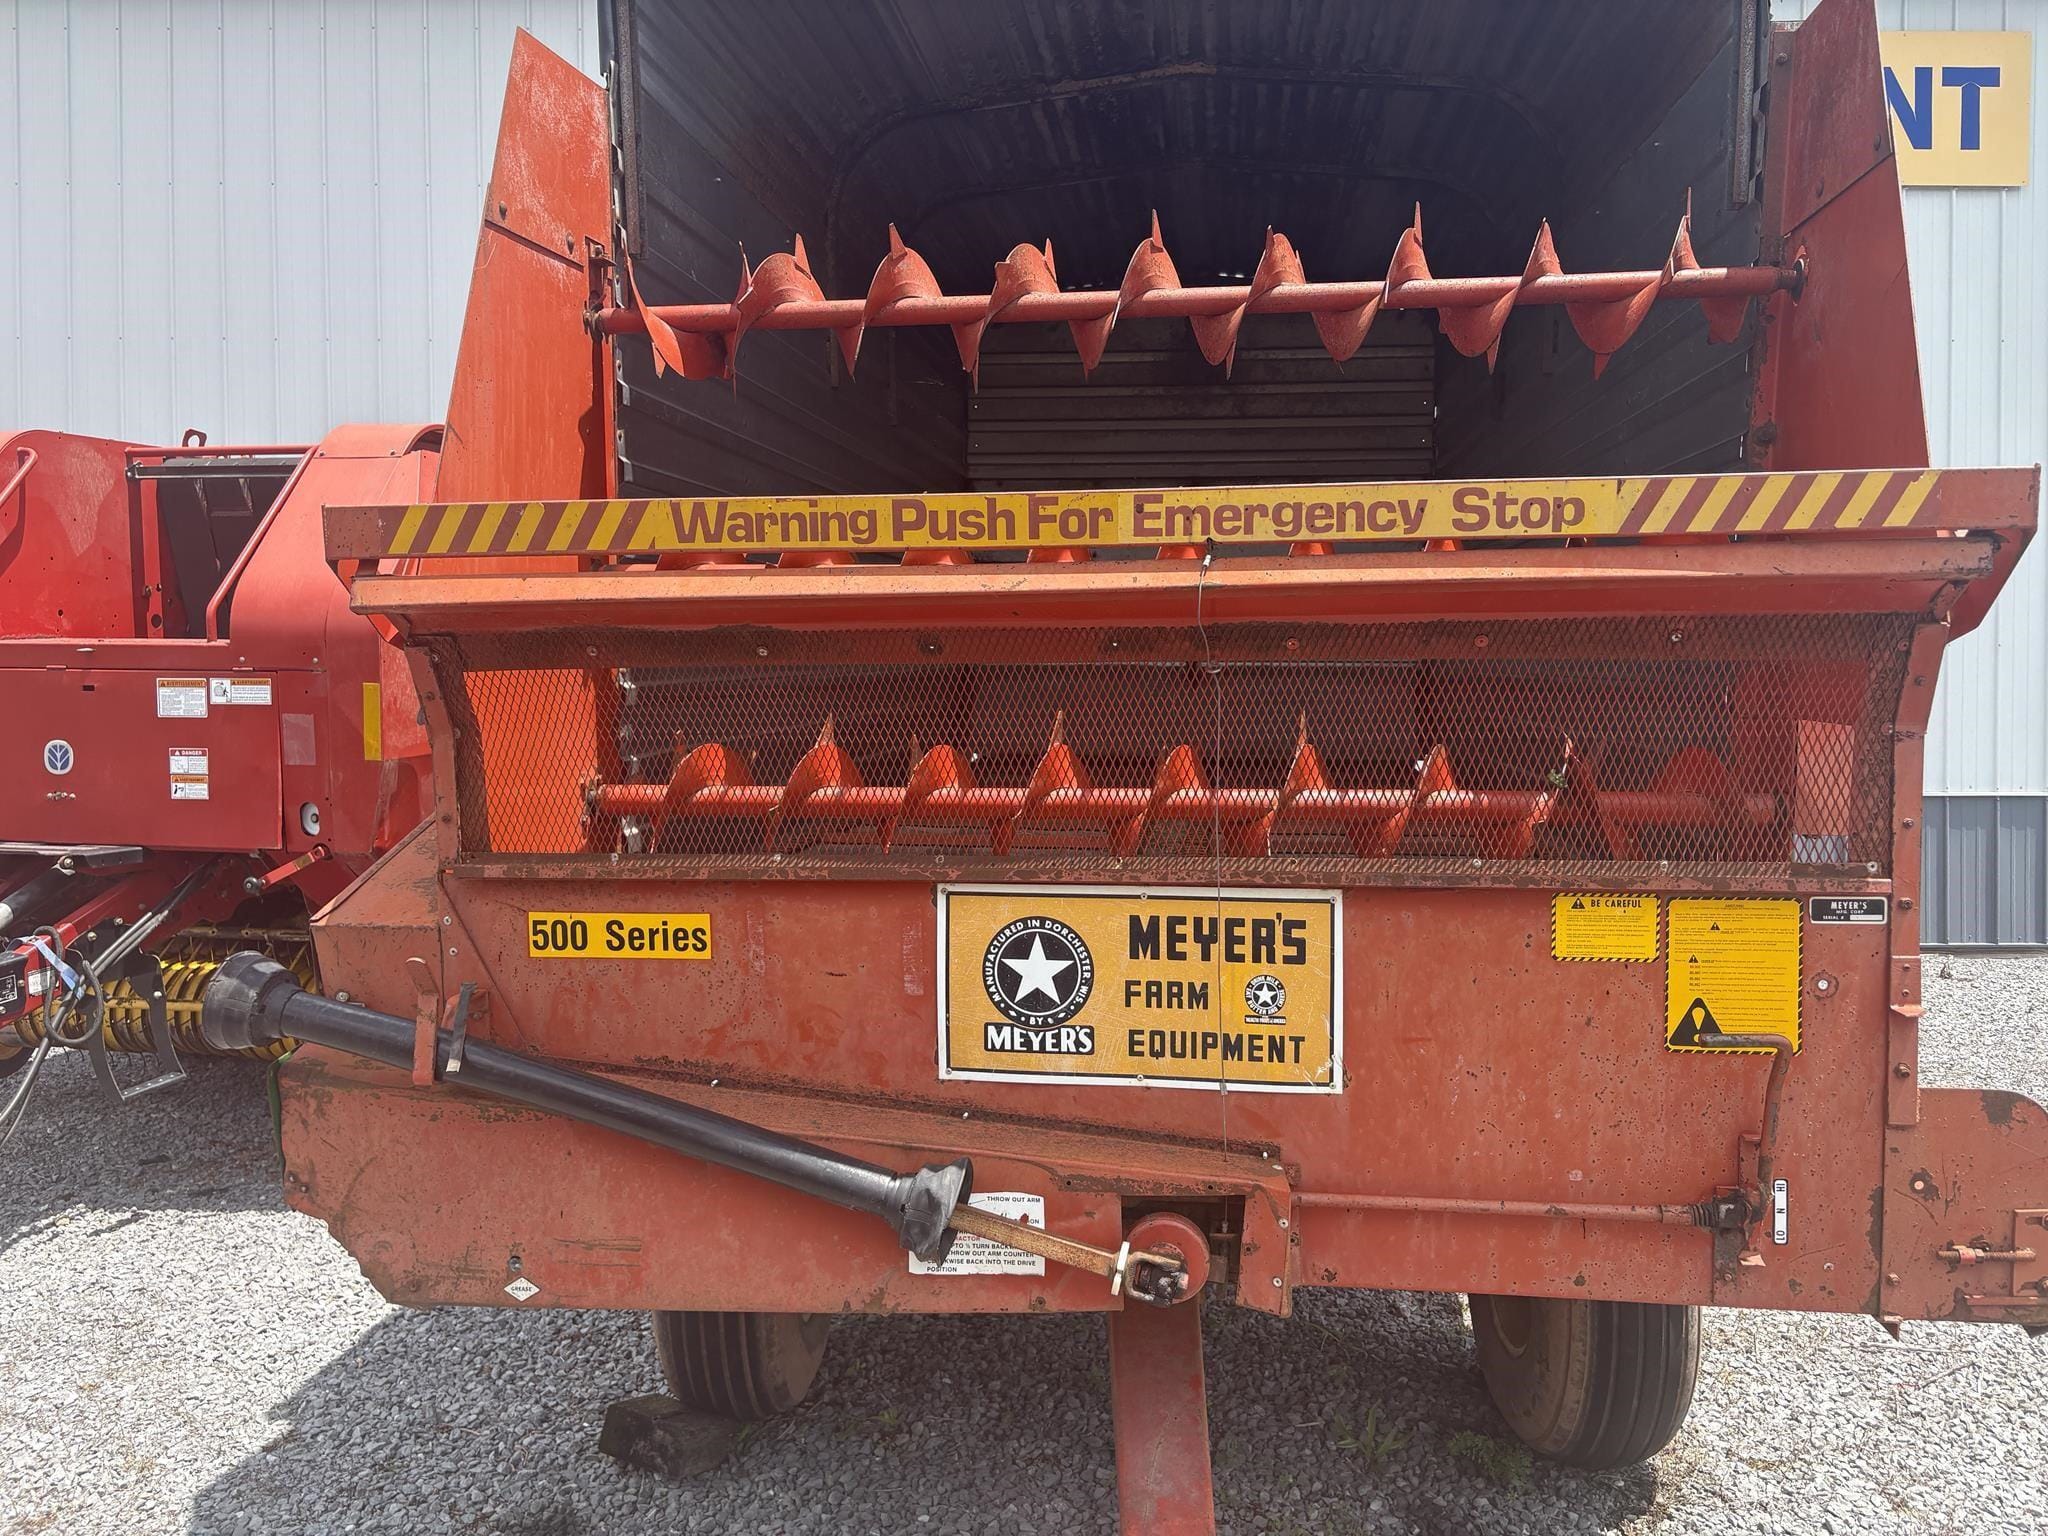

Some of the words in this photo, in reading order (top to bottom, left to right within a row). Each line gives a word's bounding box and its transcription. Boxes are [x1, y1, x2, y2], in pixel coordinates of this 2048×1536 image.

[670, 499, 878, 544] Warning
[892, 496, 1016, 541] Push
[1029, 495, 1114, 540] For
[1133, 494, 1428, 537] Emergency
[1451, 487, 1586, 532] Stop
[1590, 899, 1600, 907] BE
[1604, 899, 1642, 908] CAREFUL
[1830, 901, 1868, 909] MEYER'S
[532, 919, 588, 951] 500
[605, 920, 708, 952] Series
[1128, 912, 1307, 965] MEYER'S
[985, 922, 1024, 1002] MANUFACTURED
[1125, 980, 1209, 1010] FARM
[1029, 1016, 1043, 1025] BY
[987, 1025, 1093, 1053] MEYER'S
[1128, 1029, 1306, 1063] EQUIPMENT
[1776, 1183, 1785, 1192] HI
[1776, 1230, 1785, 1240] LO
